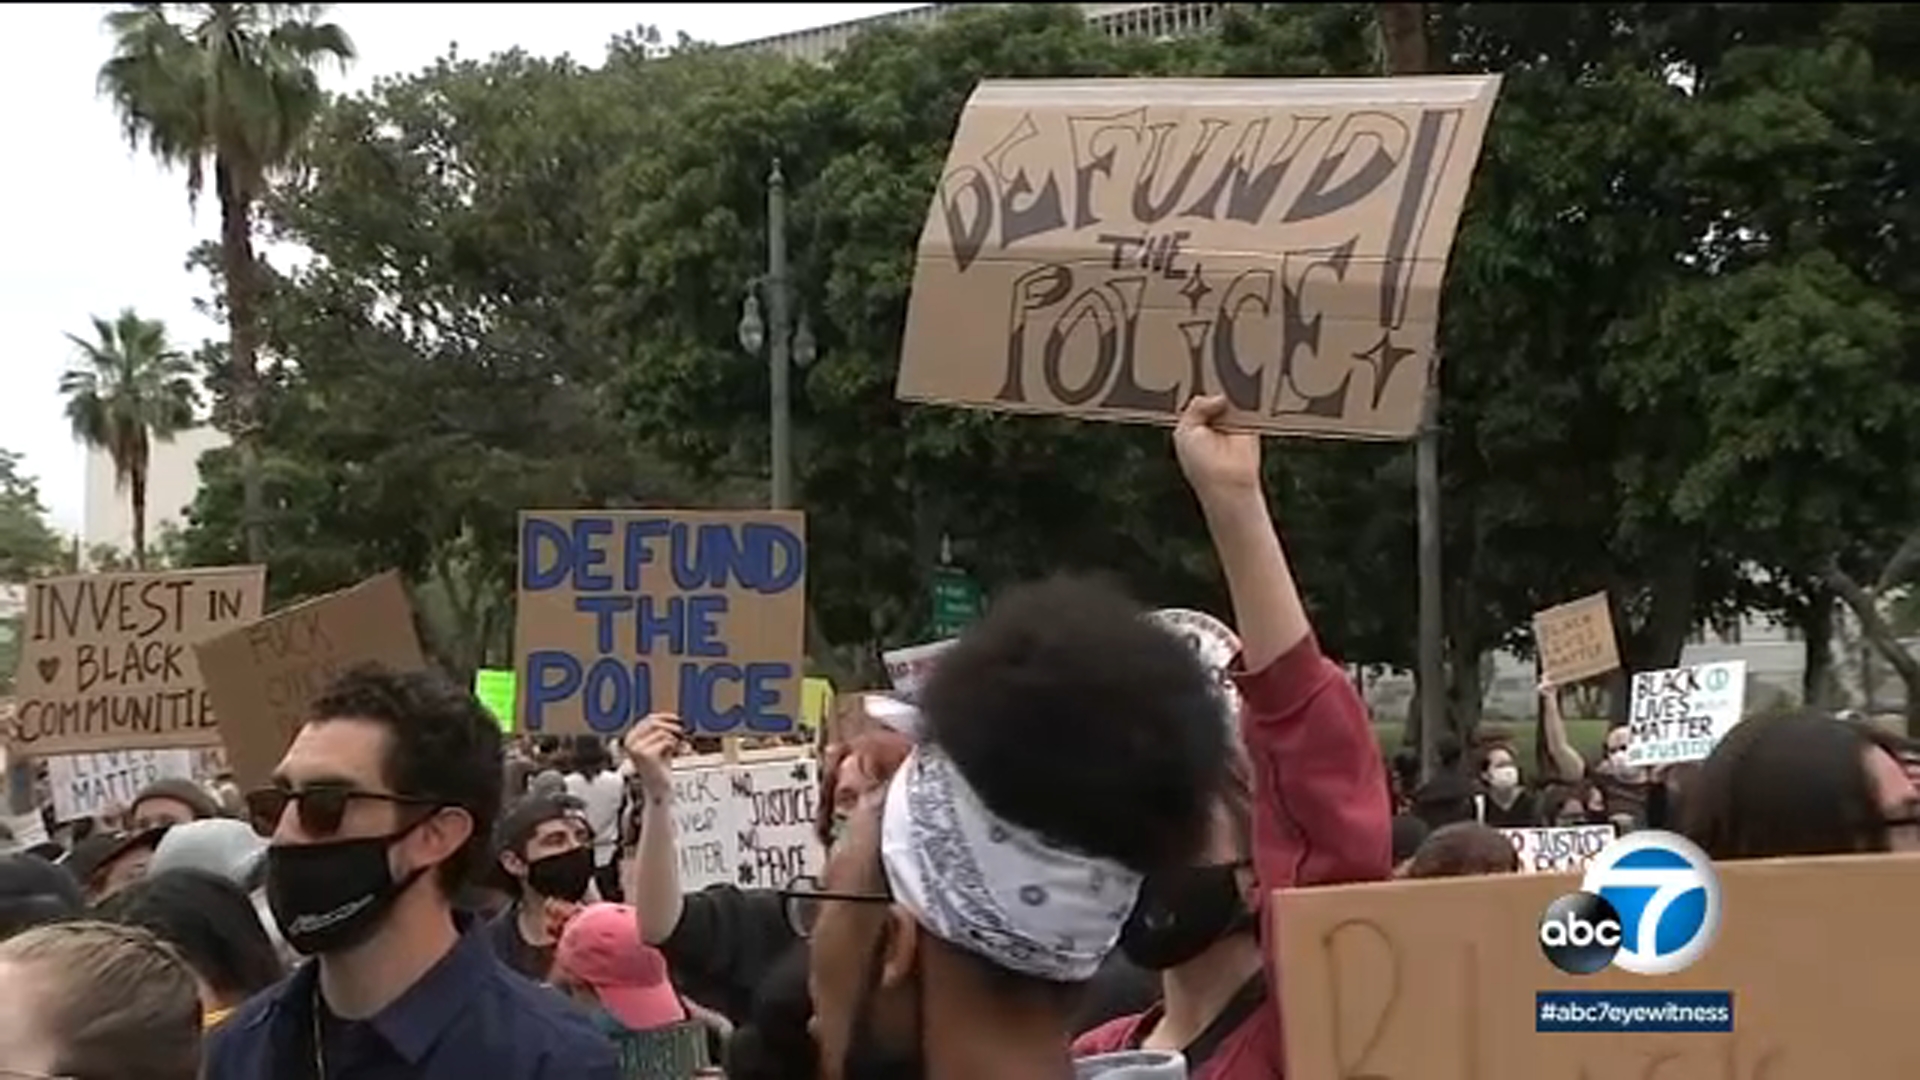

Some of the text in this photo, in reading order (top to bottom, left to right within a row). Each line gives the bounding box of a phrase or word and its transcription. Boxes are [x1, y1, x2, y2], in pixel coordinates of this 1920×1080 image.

[1097, 232, 1190, 281] THE
[996, 236, 1360, 418] POLICE
[521, 518, 803, 594] DEFUND
[31, 580, 243, 641] INVEST IN
[575, 595, 728, 657] THE
[76, 640, 183, 692] BLACK
[1637, 667, 1702, 700] BLACK
[18, 688, 219, 743] COMMUNITIE
[1628, 715, 1713, 744] MATTER
[1634, 695, 1691, 723] LIVES
[675, 771, 720, 802] ACK
[731, 771, 753, 798] NO
[751, 785, 817, 826] JUSTICE
[680, 841, 730, 877] ATTER
[737, 827, 760, 854] NO
[757, 843, 806, 887] PEACE
